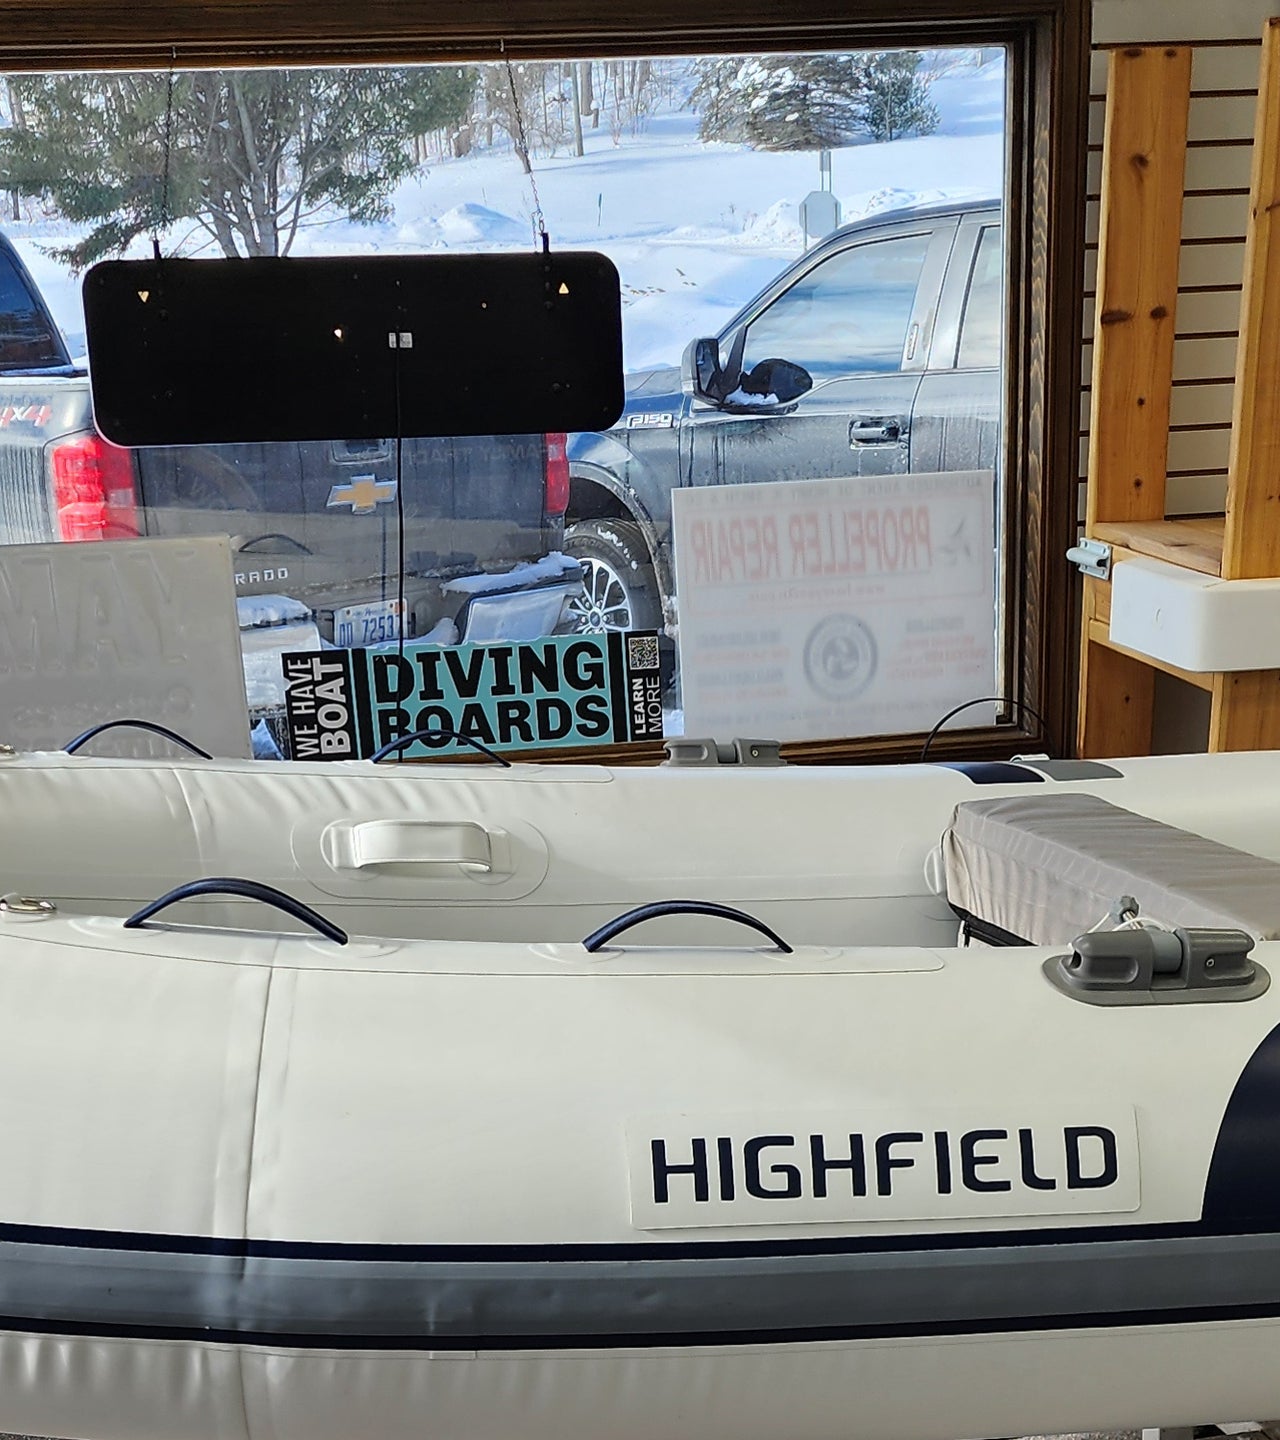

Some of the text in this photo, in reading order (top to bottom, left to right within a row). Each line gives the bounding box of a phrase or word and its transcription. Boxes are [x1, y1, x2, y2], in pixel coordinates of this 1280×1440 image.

[374, 641, 606, 703] DIVING
[286, 656, 320, 758] WE HAVE
[314, 656, 350, 756] BOAT
[376, 694, 611, 754] BOARDS
[634, 677, 647, 736] LEARN
[648, 676, 662, 734] MORE
[651, 1126, 1119, 1204] HIGHFIELD
